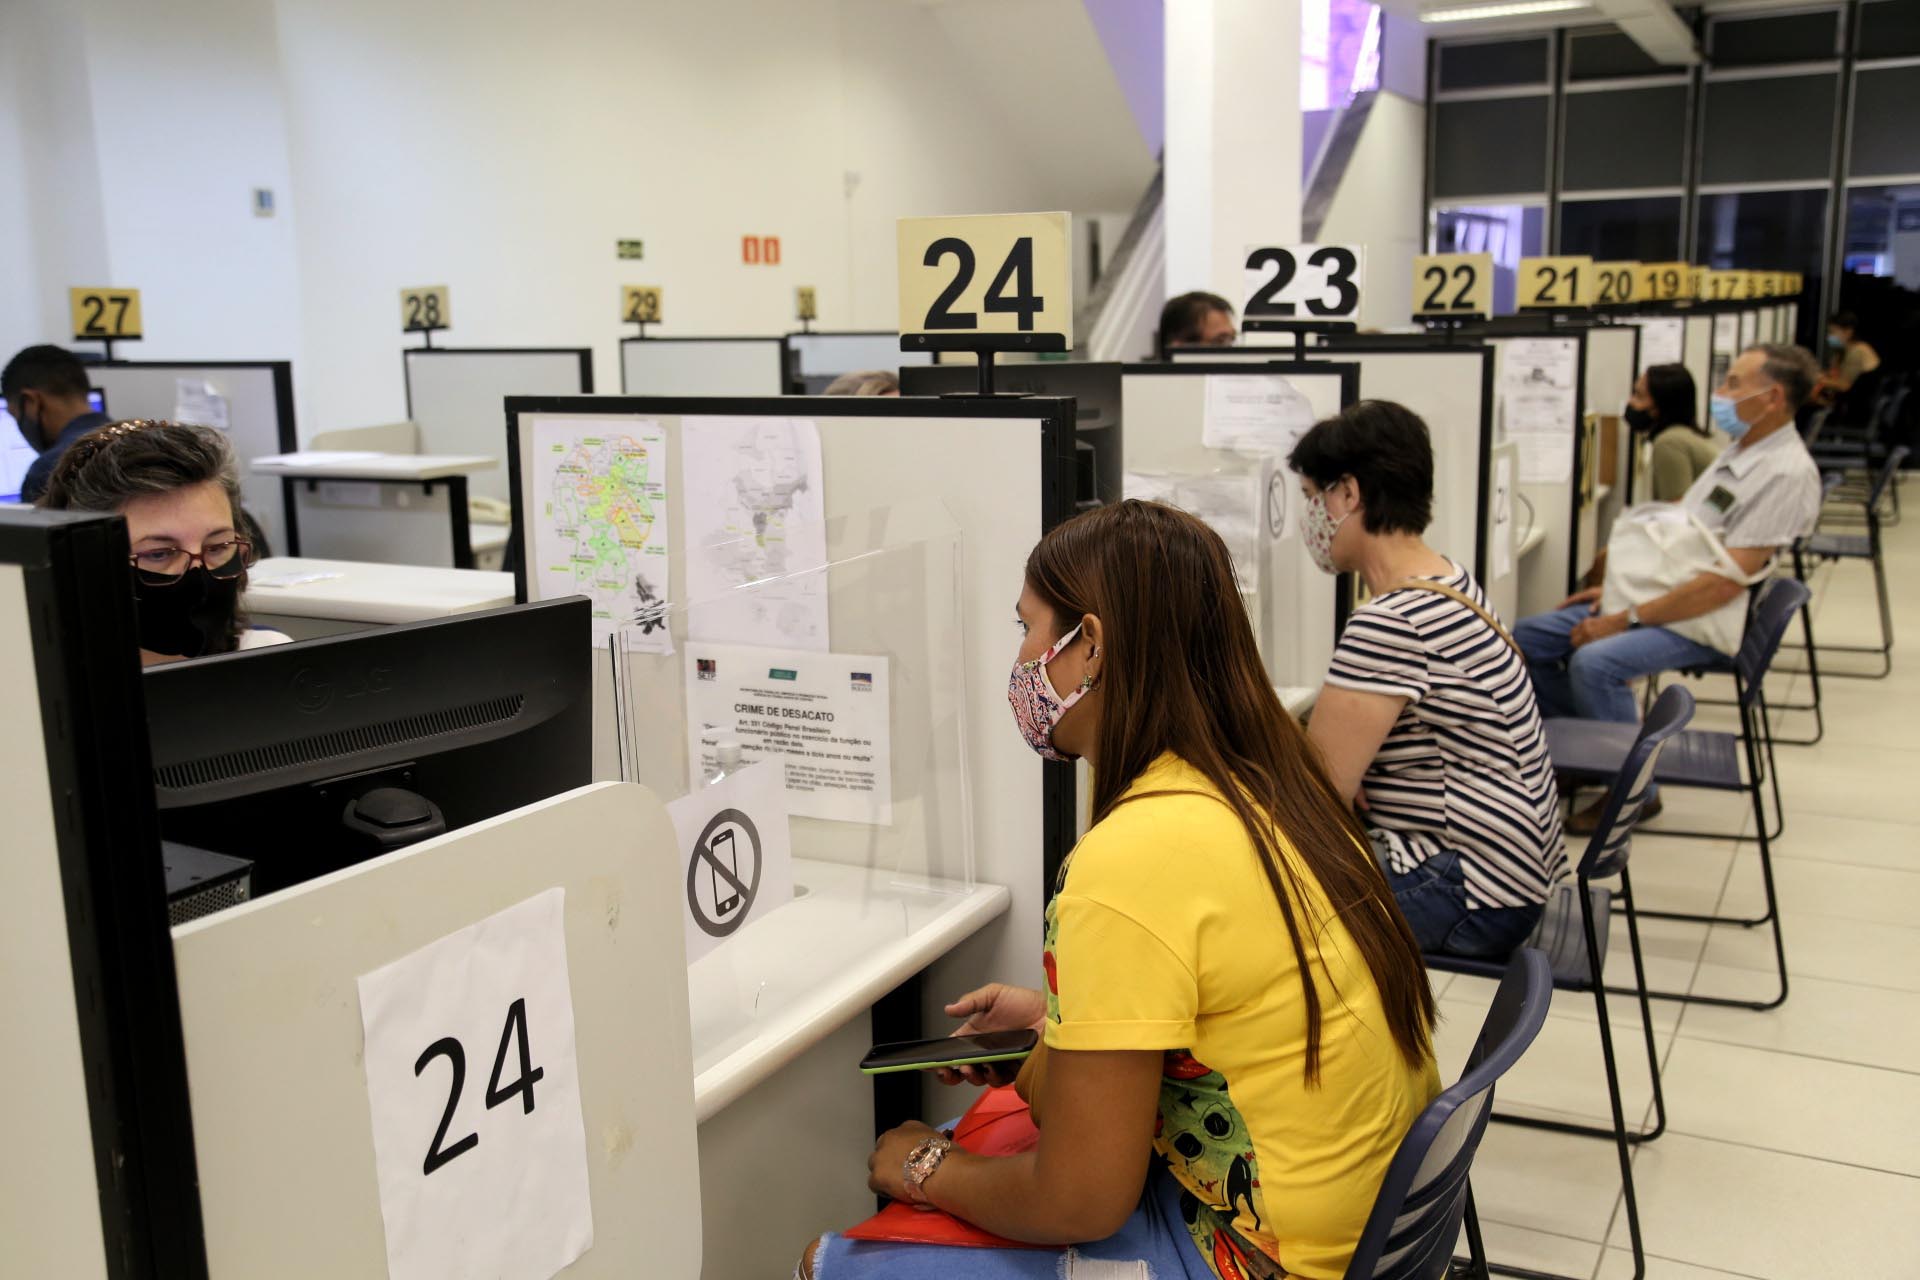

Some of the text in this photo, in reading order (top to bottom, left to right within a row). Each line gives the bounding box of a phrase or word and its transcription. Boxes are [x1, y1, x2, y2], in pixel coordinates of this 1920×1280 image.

[923, 237, 1043, 331] 24
[1244, 247, 1360, 317] 23
[1423, 264, 1476, 310] 22
[1535, 266, 1579, 302] 21
[1599, 270, 1632, 300] 20
[1647, 270, 1680, 299] 19
[1711, 276, 1739, 299] 17
[81, 295, 131, 335] 27
[407, 293, 441, 328] 28
[630, 289, 658, 320] 29
[734, 703, 835, 722] CRIME DE DESACATO
[839, 738, 861, 746] função
[415, 997, 544, 1176] 24
